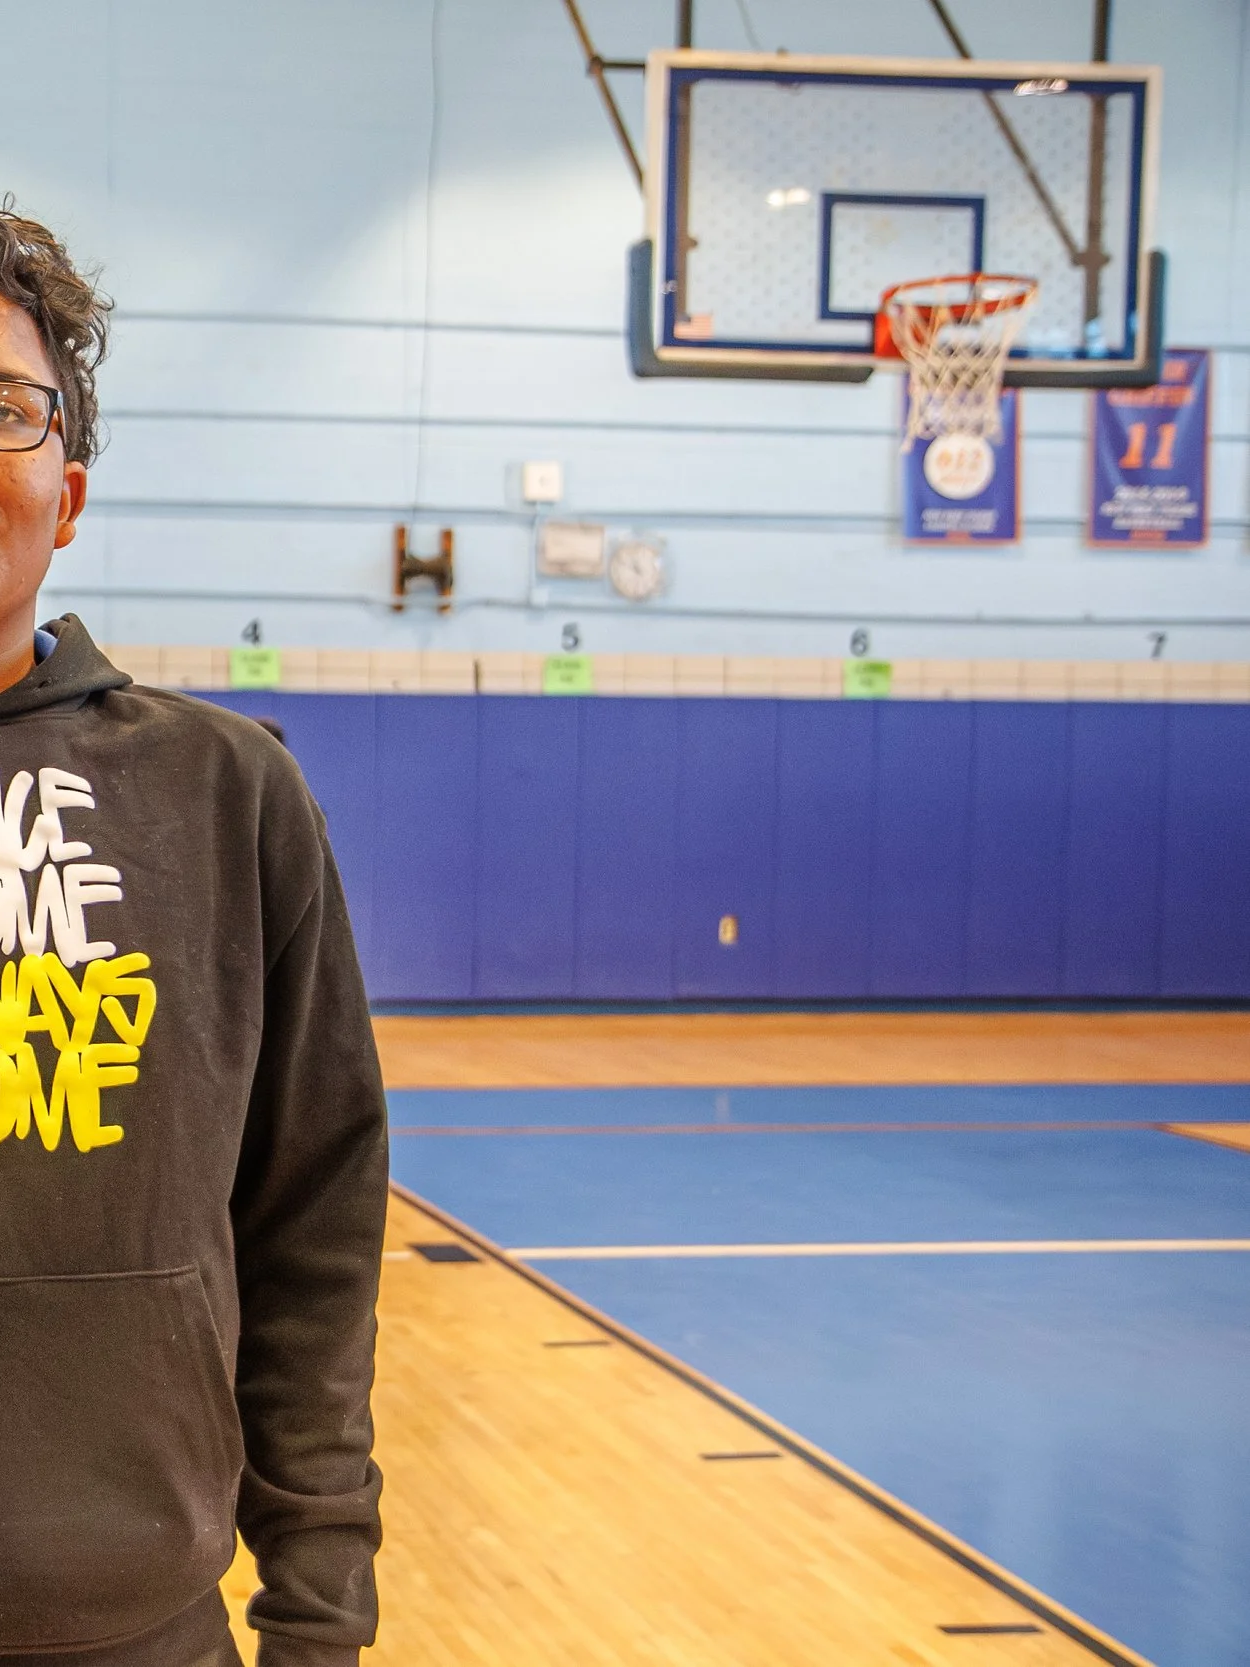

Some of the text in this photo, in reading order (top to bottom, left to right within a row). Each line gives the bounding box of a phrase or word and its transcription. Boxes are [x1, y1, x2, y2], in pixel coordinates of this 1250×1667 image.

[241, 618, 261, 647] 4
[561, 623, 580, 652] 5
[850, 628, 870, 657] 6
[1146, 631, 1168, 660] 7
